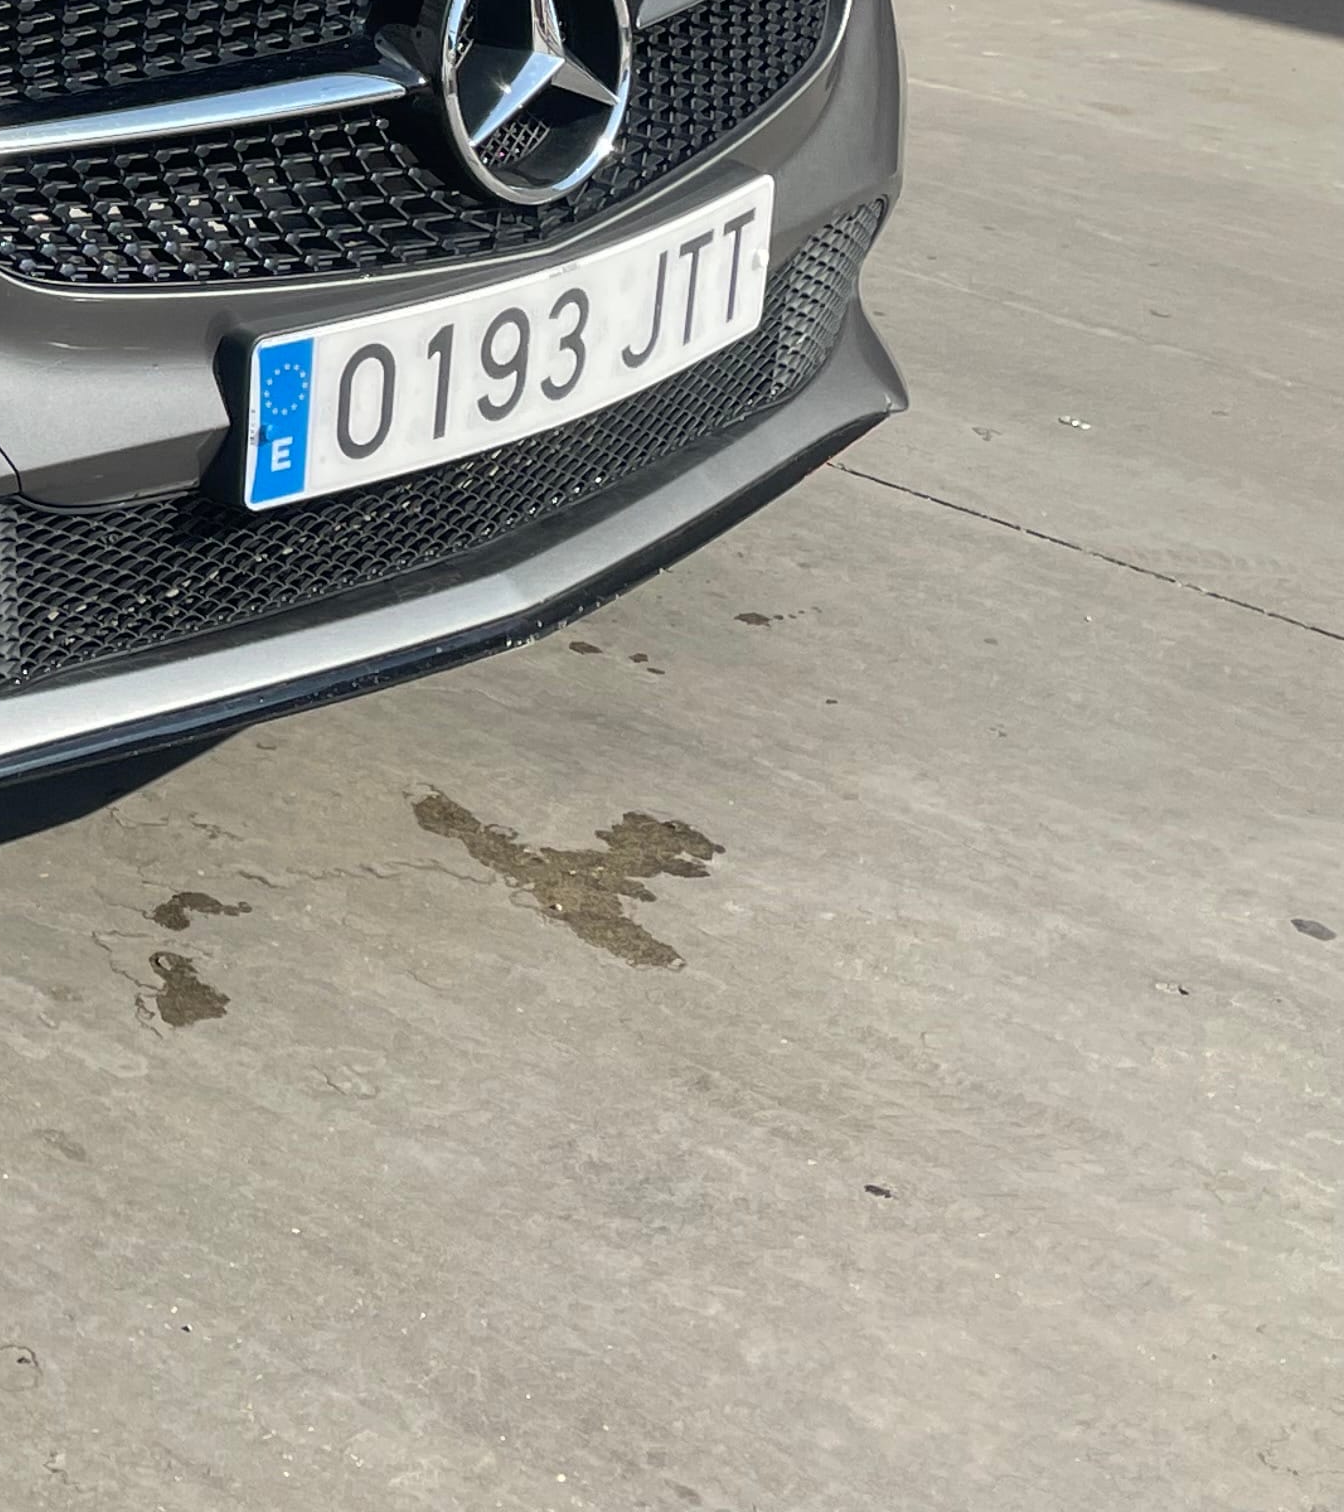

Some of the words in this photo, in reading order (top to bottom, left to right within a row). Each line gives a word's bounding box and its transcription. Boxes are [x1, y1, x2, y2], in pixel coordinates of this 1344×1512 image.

[336, 287, 590, 460] 0193
[621, 207, 756, 369] JTT
[271, 435, 293, 473] E
